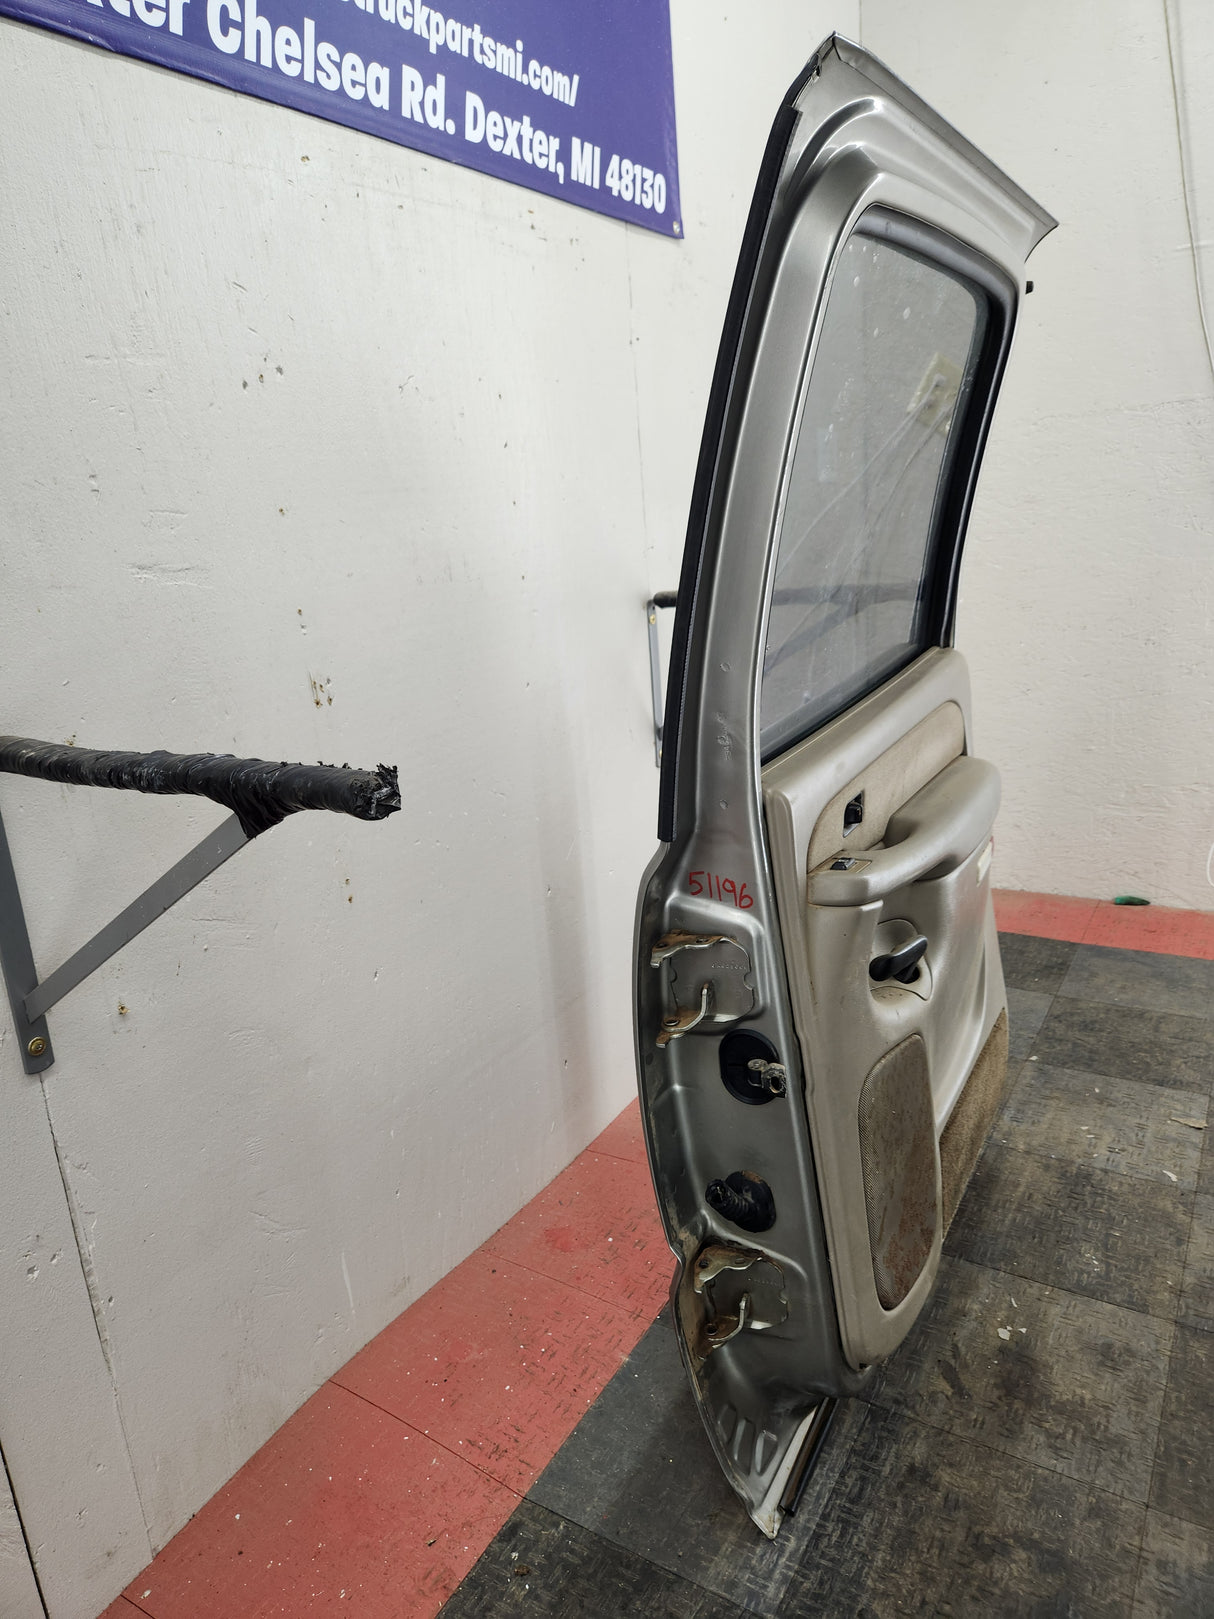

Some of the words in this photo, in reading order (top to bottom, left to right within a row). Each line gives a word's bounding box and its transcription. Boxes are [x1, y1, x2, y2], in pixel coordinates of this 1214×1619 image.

[206, 0, 390, 111] Chelsea
[401, 64, 456, 135] Rd.
[464, 90, 564, 185] Dexter,
[570, 136, 601, 190] MI
[605, 154, 667, 215] 48130
[688, 871, 754, 909] 51196
